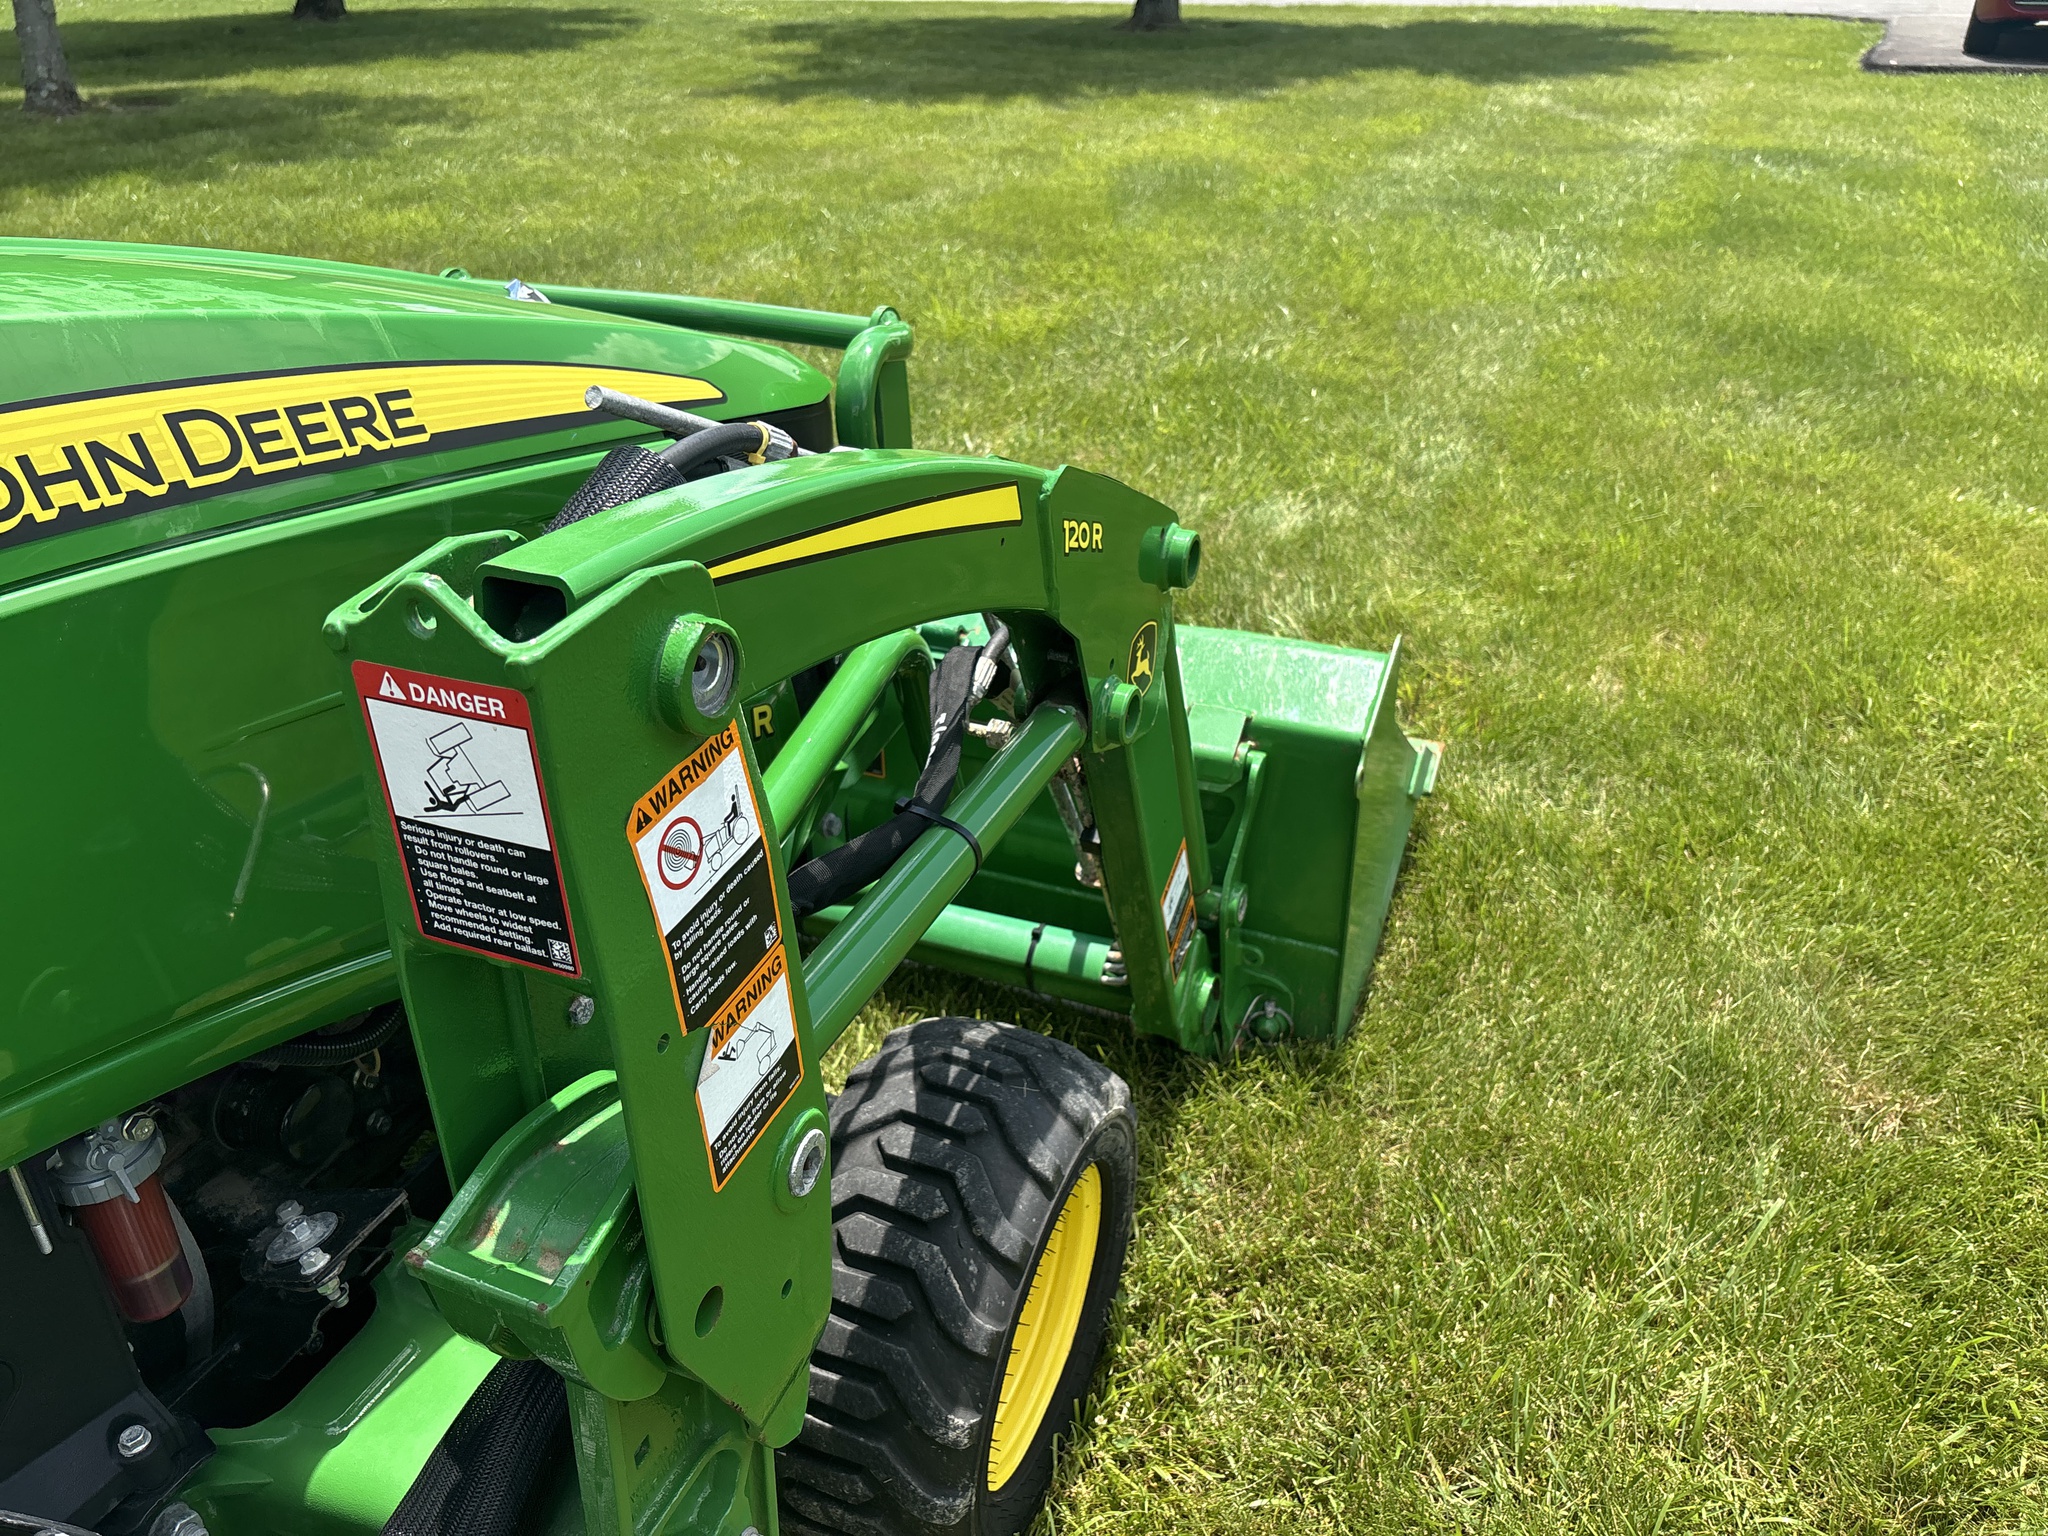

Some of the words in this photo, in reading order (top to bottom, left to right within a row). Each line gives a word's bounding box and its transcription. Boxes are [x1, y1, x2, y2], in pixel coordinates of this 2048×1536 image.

[162, 388, 429, 480] DEERE
[408, 682, 507, 719] DANGER
[753, 704, 774, 738] R
[648, 726, 735, 816] WARNING
[400, 820, 435, 836] Serious
[436, 829, 462, 845] injury
[465, 838, 475, 846] or
[478, 840, 505, 854] death
[508, 848, 526, 858] can
[404, 833, 429, 846] result
[431, 839, 452, 852] from
[455, 846, 499, 862] rollovers.
[414, 845, 428, 856] Do
[430, 850, 446, 860] not
[447, 852, 478, 869] handle
[481, 863, 509, 876] round
[524, 872, 549, 885] large
[418, 858, 448, 872] square
[450, 864, 478, 879] bales.
[420, 866, 438, 879] Use
[440, 872, 464, 887] Rops
[466, 880, 484, 891] and
[486, 885, 525, 901] seatbelt
[526, 894, 537, 904] at
[423, 879, 434, 888] all
[435, 882, 464, 896] times.
[672, 939, 682, 951] To
[681, 918, 700, 943] avoid
[700, 898, 718, 926] injury
[718, 890, 726, 902] or
[726, 872, 744, 894] death
[743, 849, 764, 876] caused
[425, 889, 462, 906] Operate
[464, 899, 496, 914] tractor
[498, 908, 508, 916] at
[509, 910, 527, 922] low
[529, 916, 562, 930] speed.
[428, 899, 453, 912] Move
[454, 907, 488, 922] wheels
[490, 916, 500, 925] to
[501, 919, 534, 934] widest
[431, 912, 496, 934] recommended
[498, 929, 534, 944] setting.
[434, 920, 452, 932] Add
[454, 928, 492, 943] required
[493, 937, 512, 948] rear
[514, 941, 549, 958] ballast.
[674, 948, 684, 960] by
[684, 928, 704, 952] falling
[704, 906, 724, 930] loads:
[681, 962, 692, 975] Do
[692, 949, 703, 964] not
[703, 924, 724, 950] handle
[724, 906, 743, 928] round
[742, 897, 750, 909] or
[682, 964, 700, 983] large
[700, 937, 722, 965] square
[722, 920, 740, 940] bales.
[686, 969, 708, 997] Handle
[708, 947, 728, 972] raised
[728, 930, 746, 954] loads
[745, 914, 758, 934] with
[688, 976, 713, 1005] caution.
[690, 994, 708, 1016] Carry
[708, 974, 725, 996] loads
[726, 960, 738, 978] low.
[711, 954, 783, 1049] WARNING
[714, 1140, 722, 1151] To
[722, 1118, 738, 1141] avoid
[738, 1098, 754, 1121] injury
[754, 1081, 768, 1100] from
[718, 1146, 728, 1158] Do
[728, 1132, 738, 1147] not
[738, 1114, 752, 1134] work
[752, 1096, 766, 1116] from
[765, 1088, 772, 1098] or
[772, 1070, 787, 1090] allow
[720, 1144, 737, 1166] riders
[737, 1132, 746, 1144] on
[745, 1110, 762, 1134] loader
[762, 1100, 770, 1110] or
[770, 1090, 778, 1102] its
